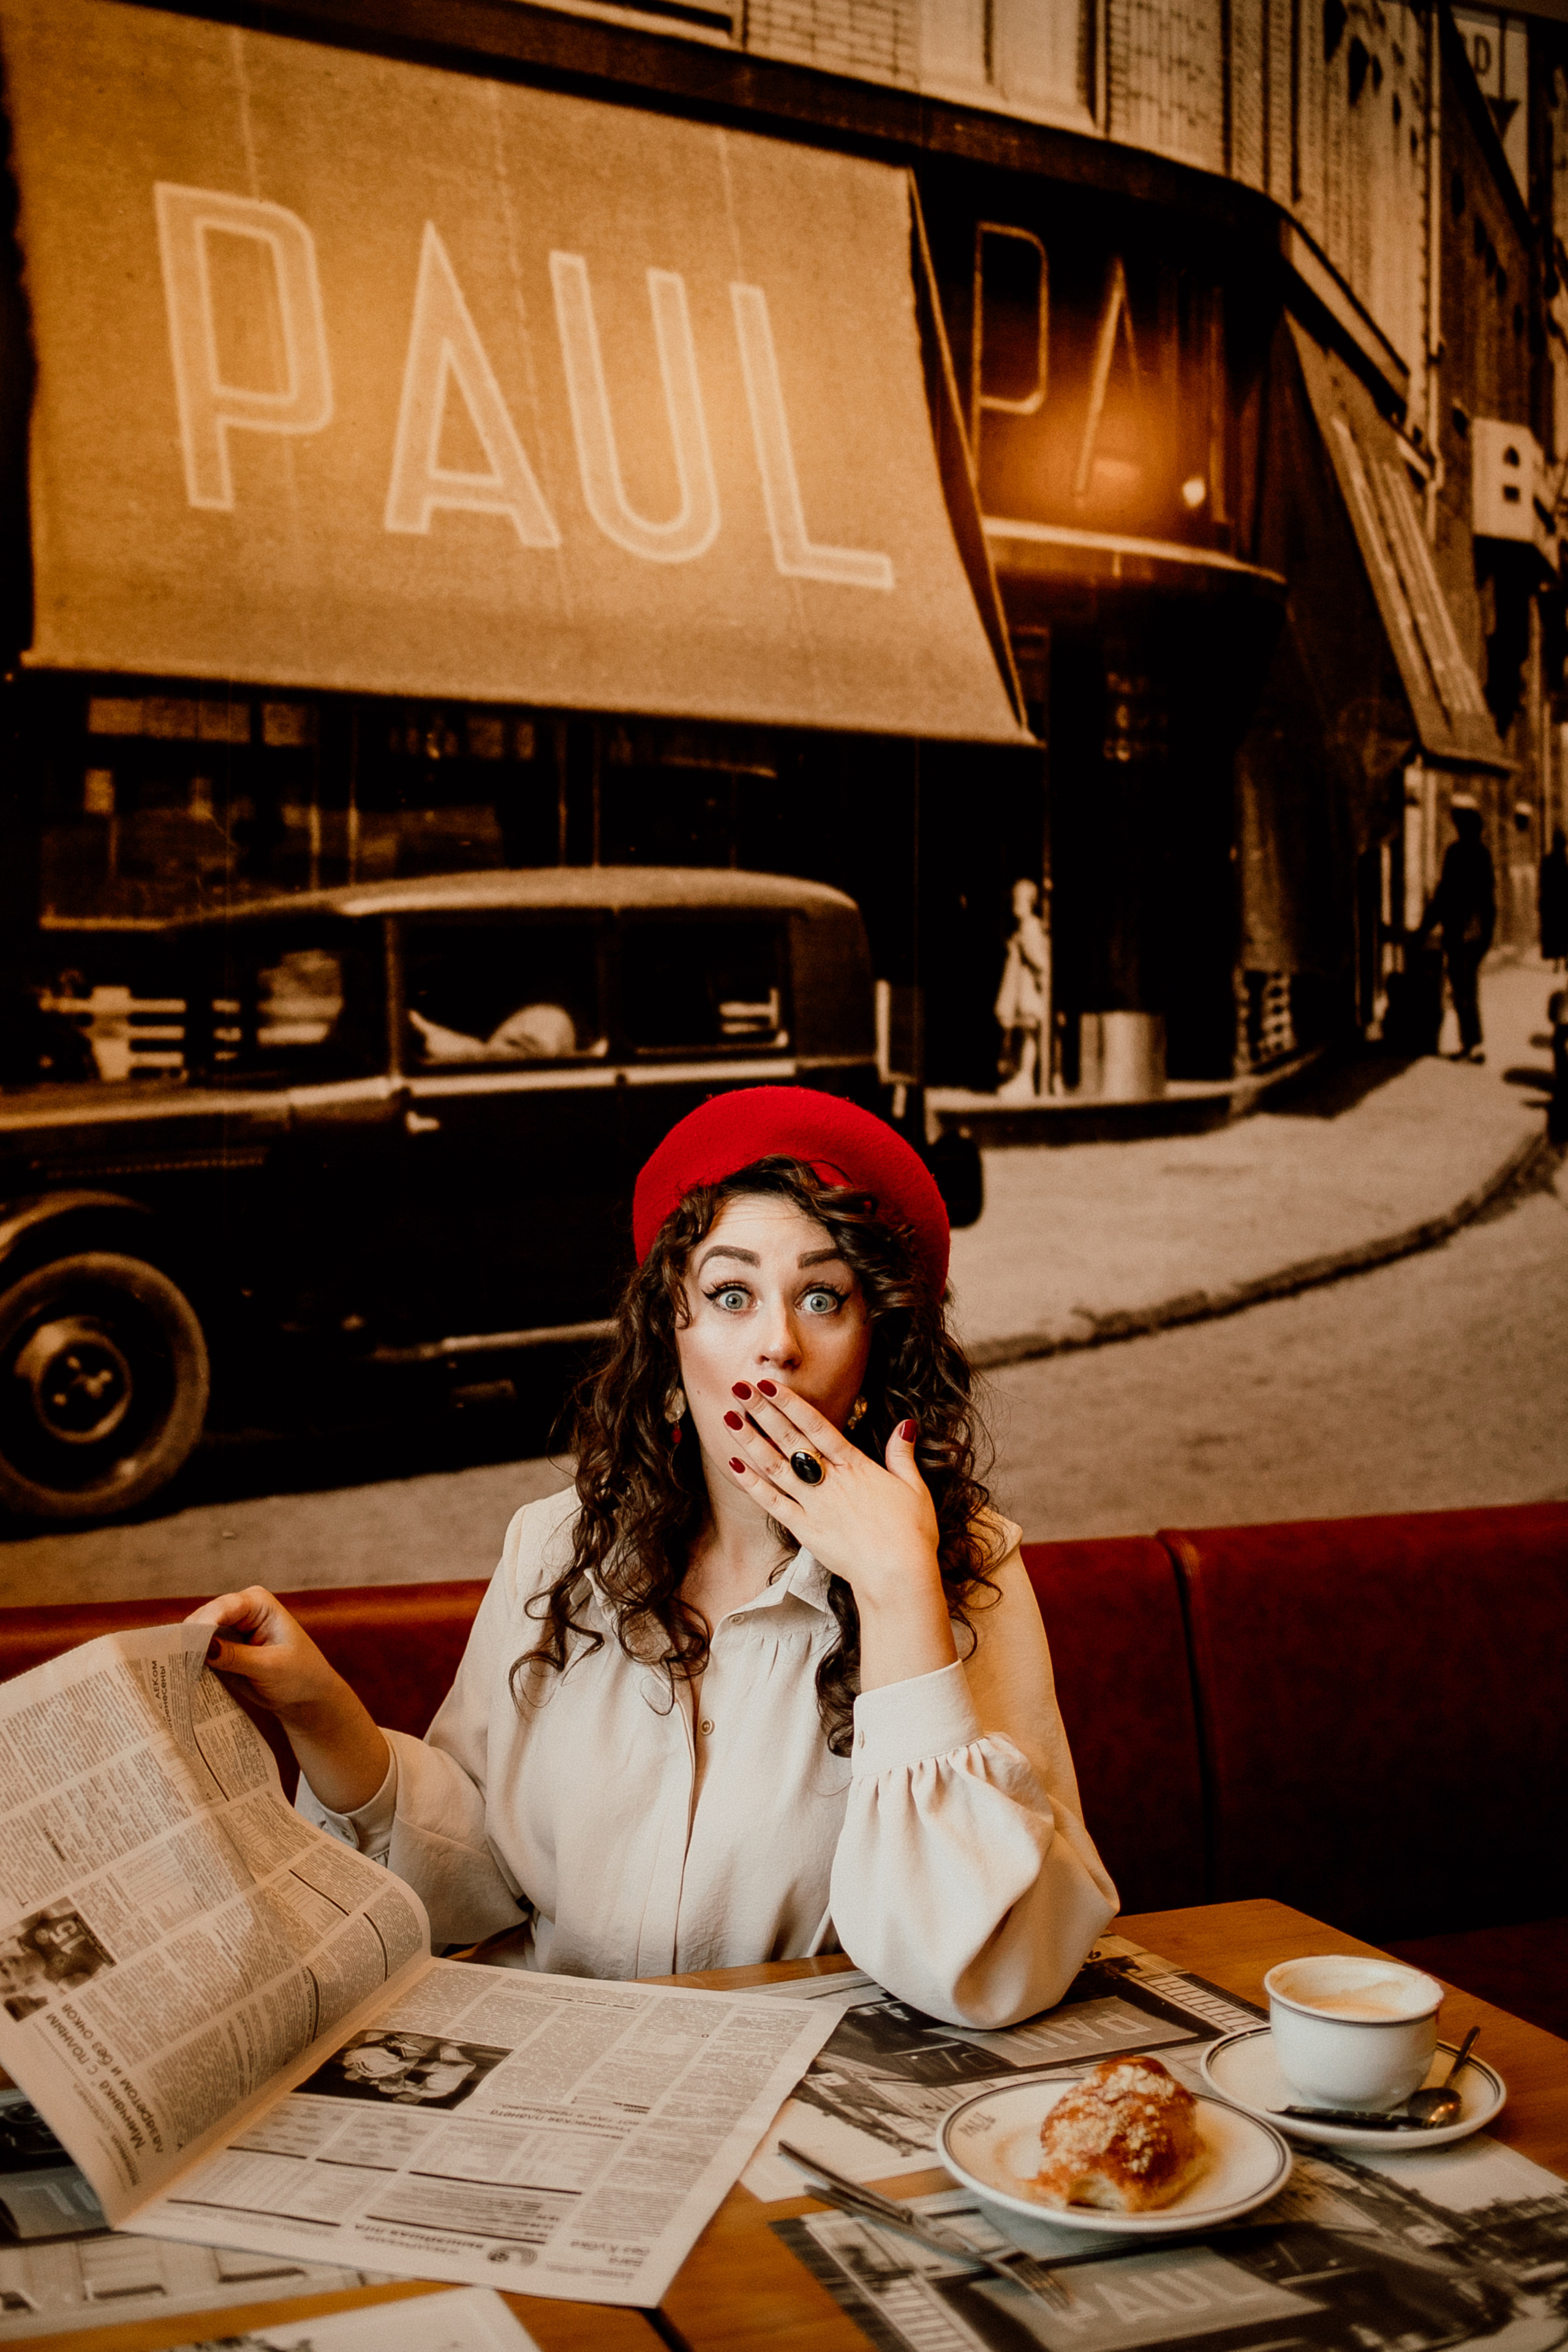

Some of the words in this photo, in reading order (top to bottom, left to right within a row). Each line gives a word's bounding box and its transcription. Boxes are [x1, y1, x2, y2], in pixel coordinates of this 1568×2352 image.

[153, 181, 895, 590] PAUL
[49, 1920, 86, 1955] 15
[45, 2012, 90, 2065] полным
[62, 2003, 94, 2040] очков
[92, 2041, 113, 2067] без
